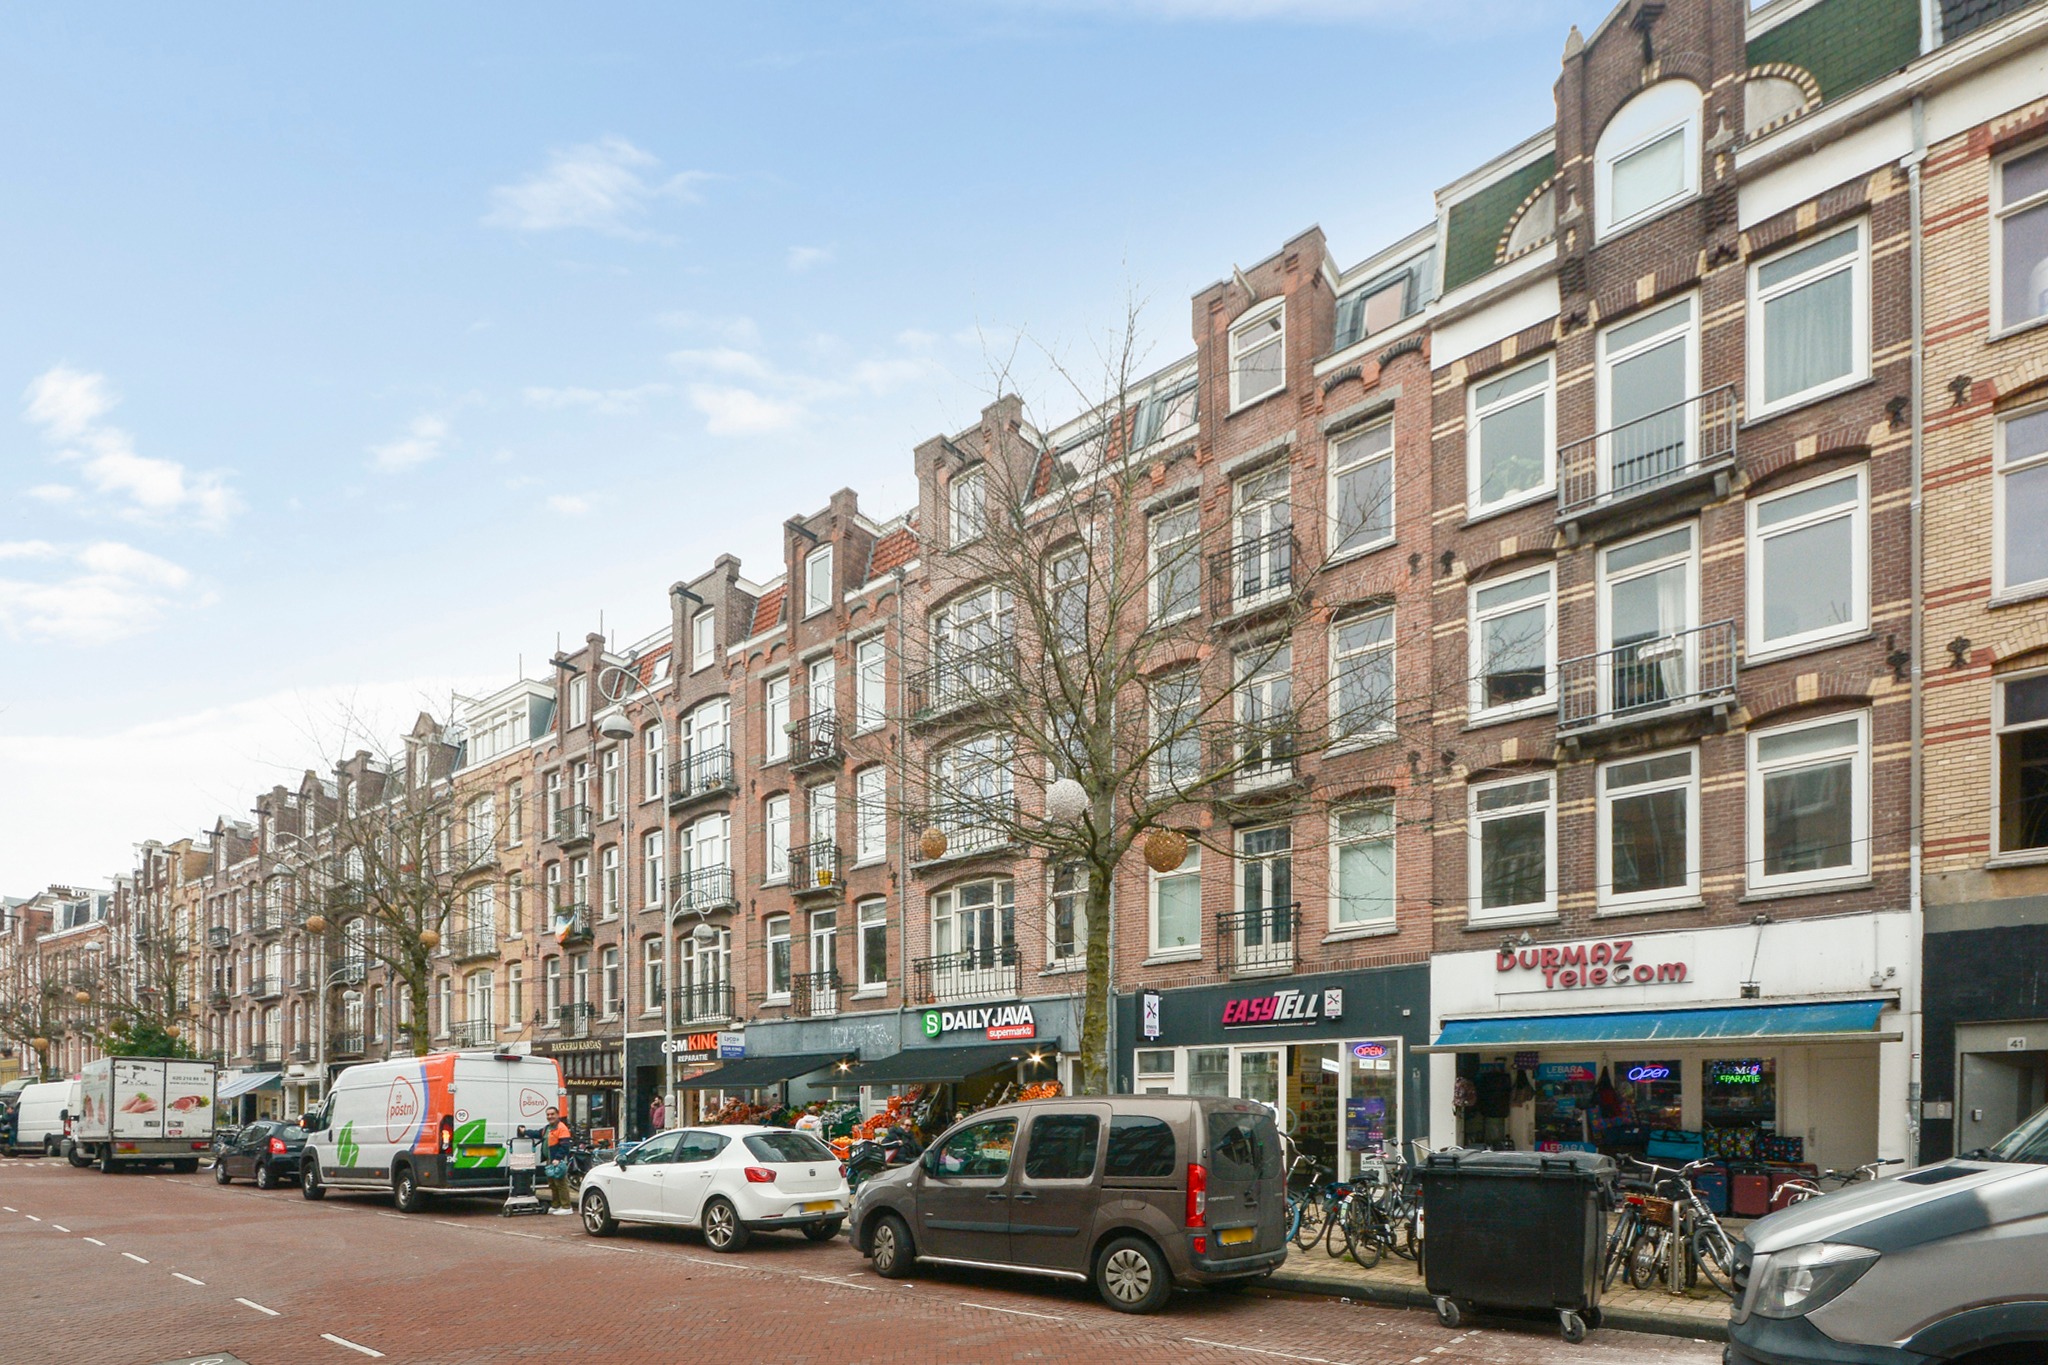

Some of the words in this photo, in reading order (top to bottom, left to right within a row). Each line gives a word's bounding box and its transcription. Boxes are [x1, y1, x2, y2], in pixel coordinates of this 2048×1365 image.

[1496, 940, 1633, 972] DURMAZ
[551, 1042, 578, 1052] BAKKERIJ
[2010, 1039, 2023, 1048] 41
[1356, 1046, 1383, 1056] OPEN
[677, 1053, 708, 1062] REPARATIE
[1546, 1065, 1585, 1074] LEBARA
[1628, 1066, 1669, 1080] Open
[390, 1101, 414, 1119] postnl
[1544, 1143, 1585, 1152] LEBARA
